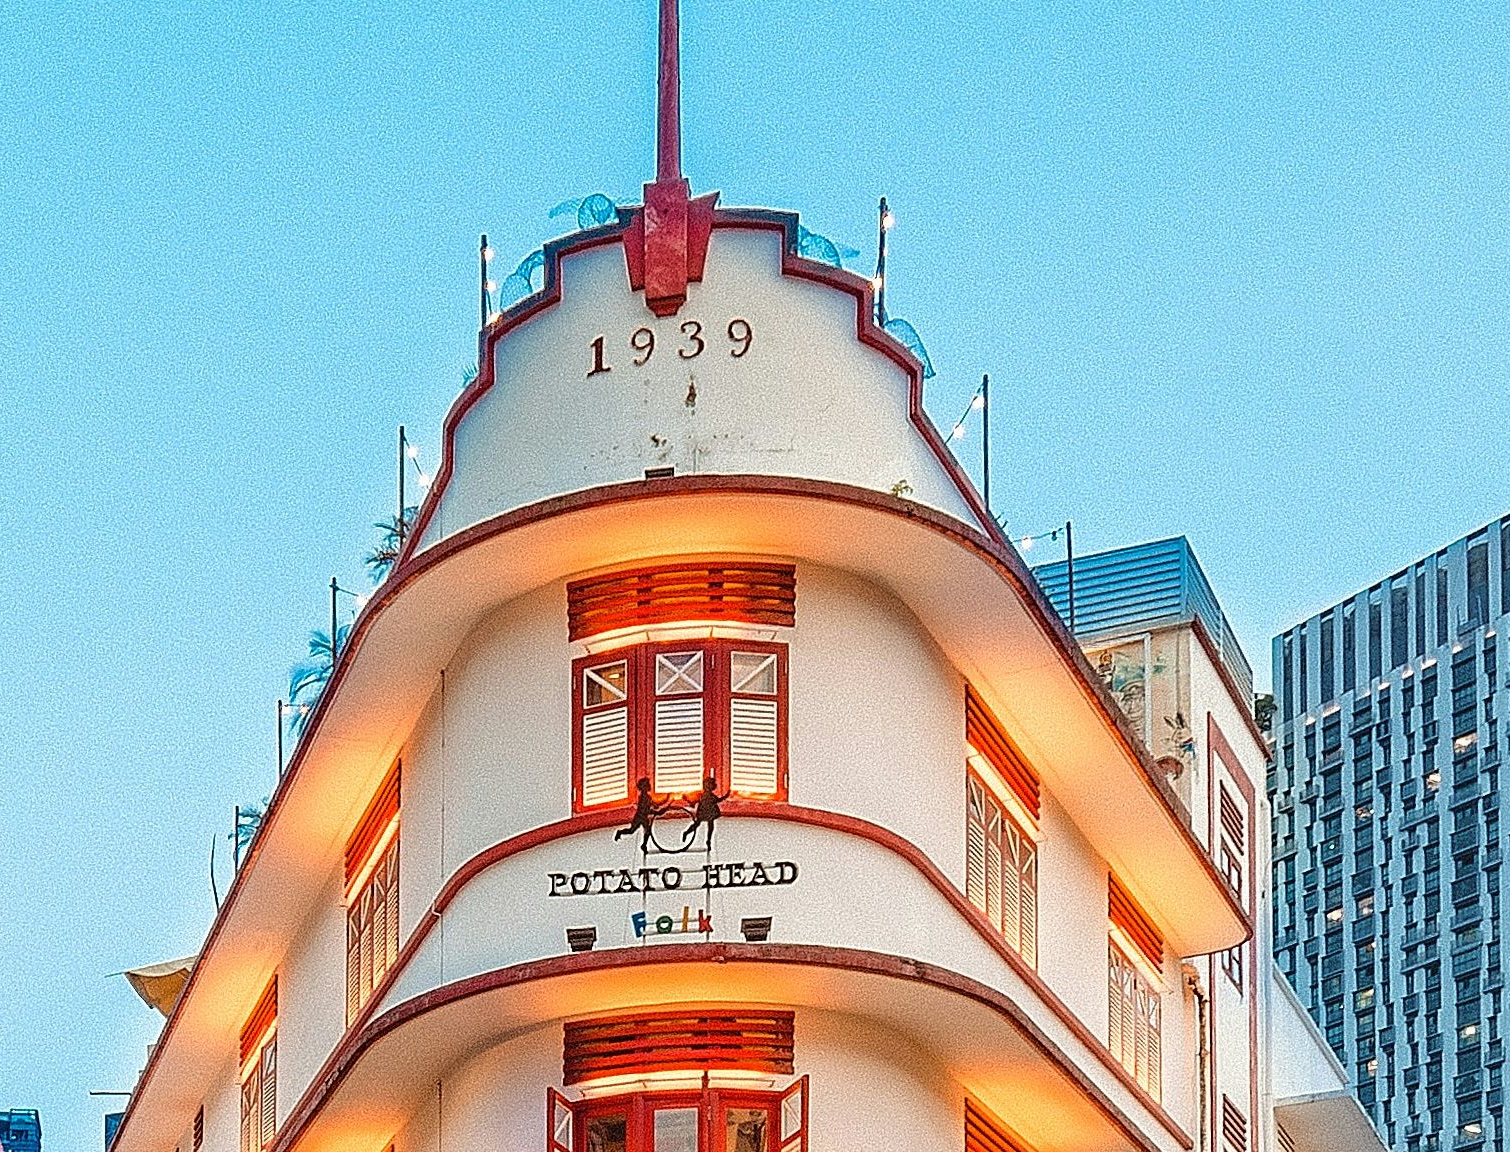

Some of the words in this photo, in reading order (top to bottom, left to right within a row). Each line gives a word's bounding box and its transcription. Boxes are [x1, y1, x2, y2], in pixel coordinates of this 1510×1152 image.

[586, 318, 753, 379] 1939
[547, 866, 683, 897] POTATO
[702, 861, 799, 889] HEAD
[631, 905, 714, 938] Folk
